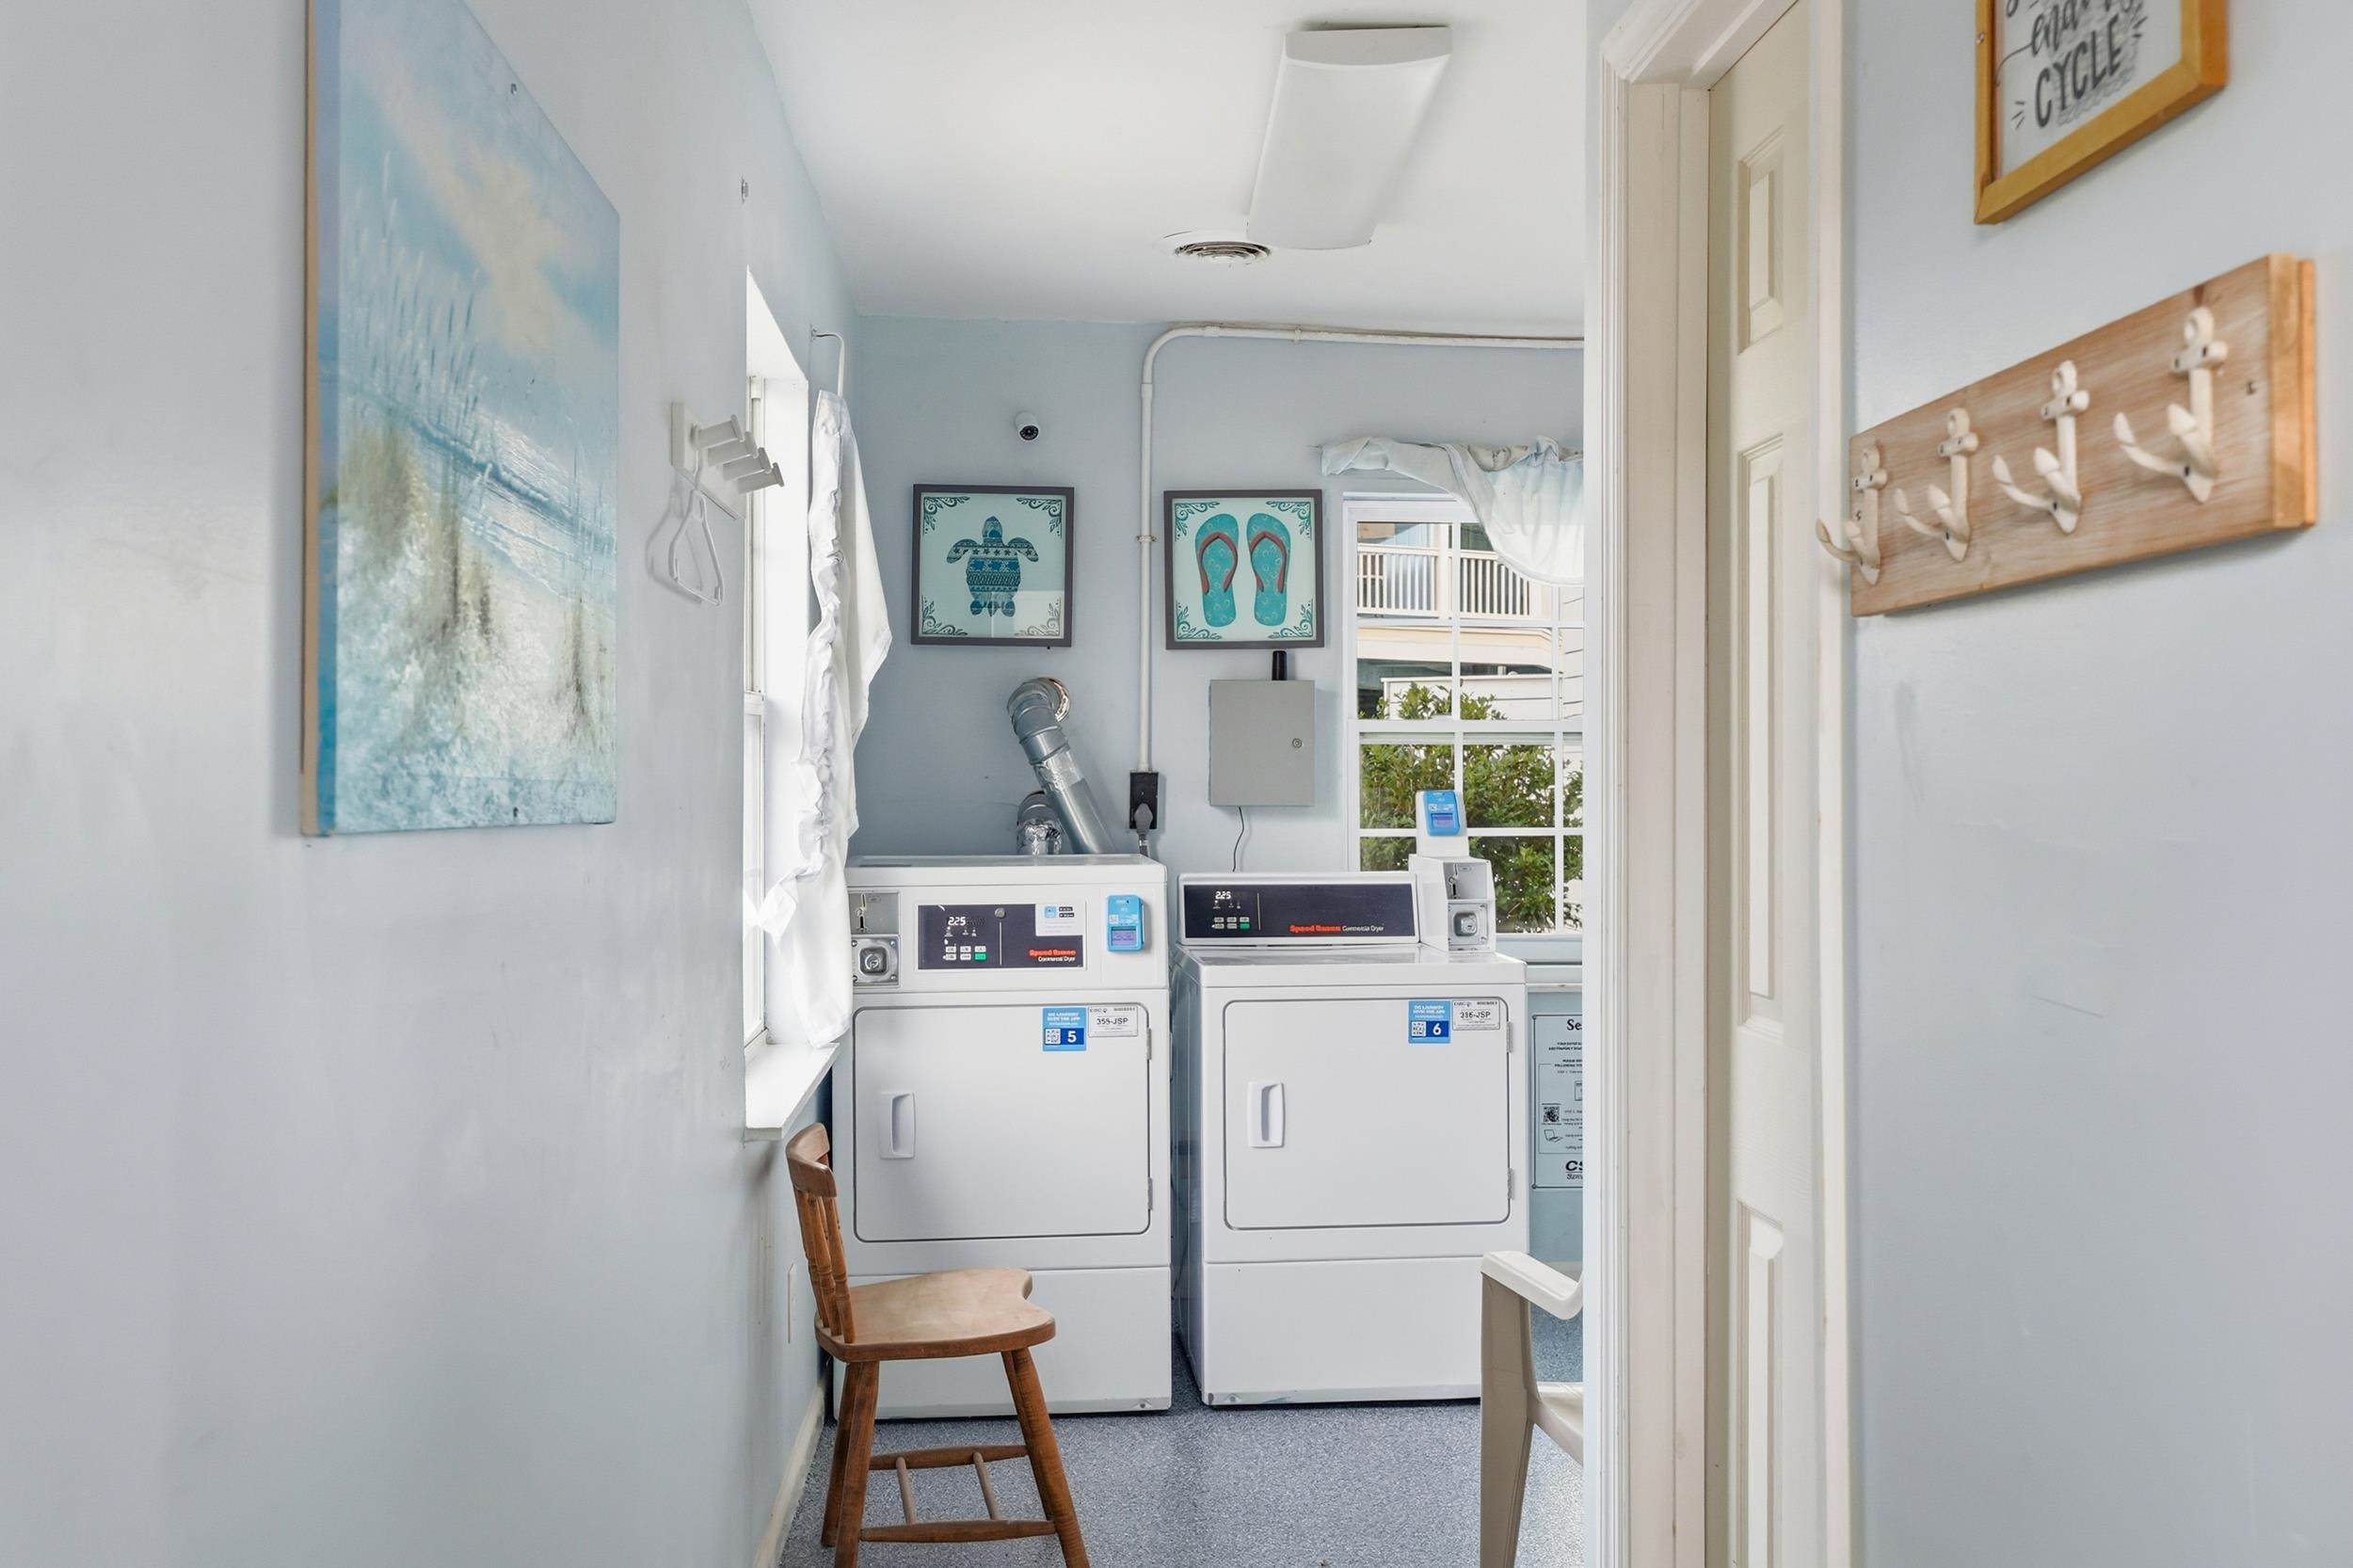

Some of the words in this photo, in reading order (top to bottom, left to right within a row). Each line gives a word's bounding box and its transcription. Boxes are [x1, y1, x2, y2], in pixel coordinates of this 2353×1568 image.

[2036, 14, 2121, 128] CYCLE
[1433, 1022, 1442, 1035] 6
[1067, 1031, 1077, 1043] 5
